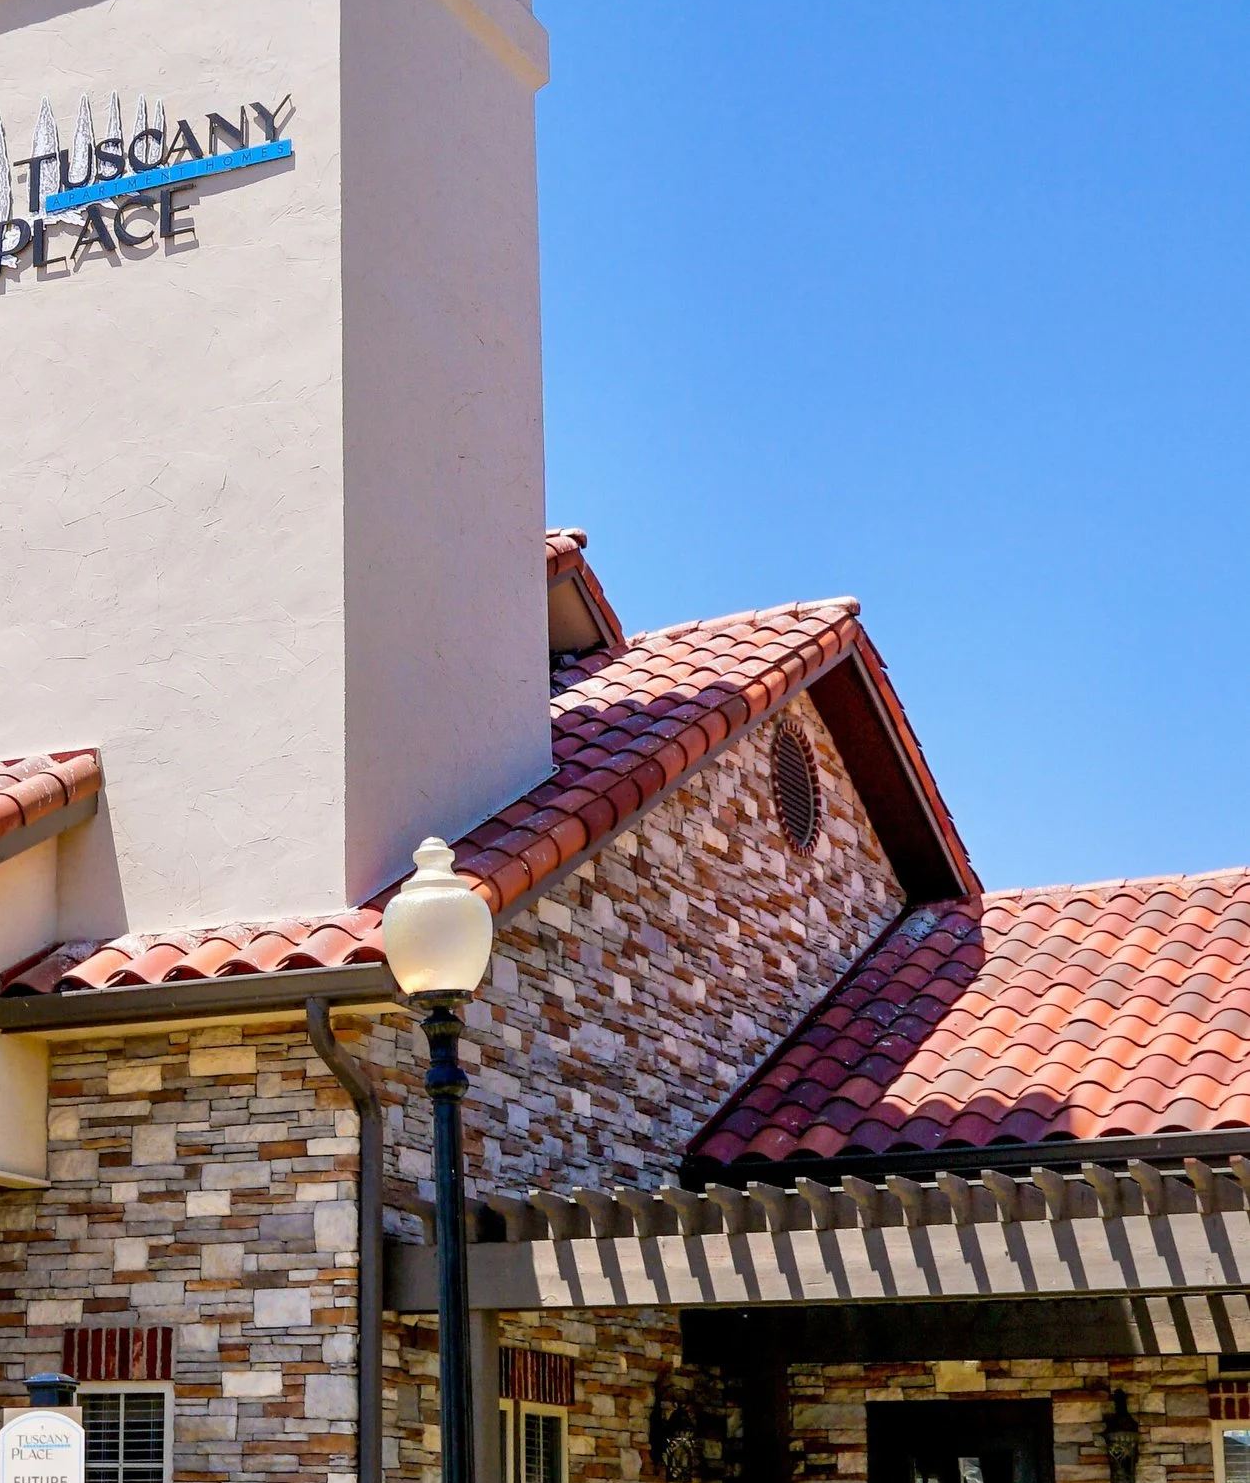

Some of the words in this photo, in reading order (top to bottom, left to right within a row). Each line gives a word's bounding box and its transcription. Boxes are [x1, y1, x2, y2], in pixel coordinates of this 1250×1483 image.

[14, 93, 292, 213] TUSCANY
[52, 168, 185, 206] APARTMENT
[205, 143, 285, 171] HOMES
[11, 1447, 54, 1461] PLACE
[16, 1434, 72, 1447] TUSCANY
